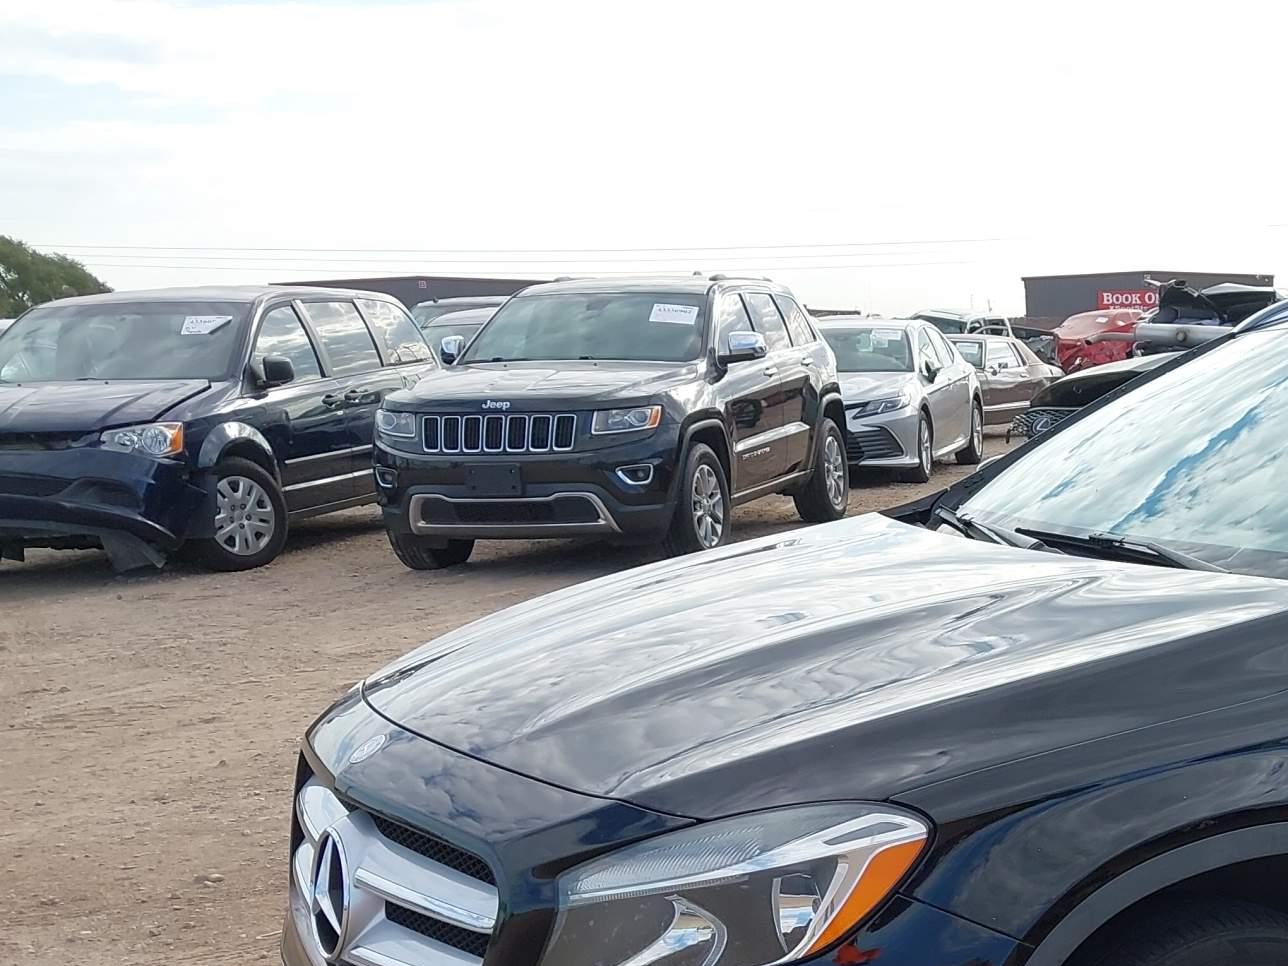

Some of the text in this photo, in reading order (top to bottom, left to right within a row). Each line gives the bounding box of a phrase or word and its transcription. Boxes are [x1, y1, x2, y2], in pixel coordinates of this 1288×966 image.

[1103, 292, 1160, 304] BOOK O
[482, 400, 510, 411] Jeep
